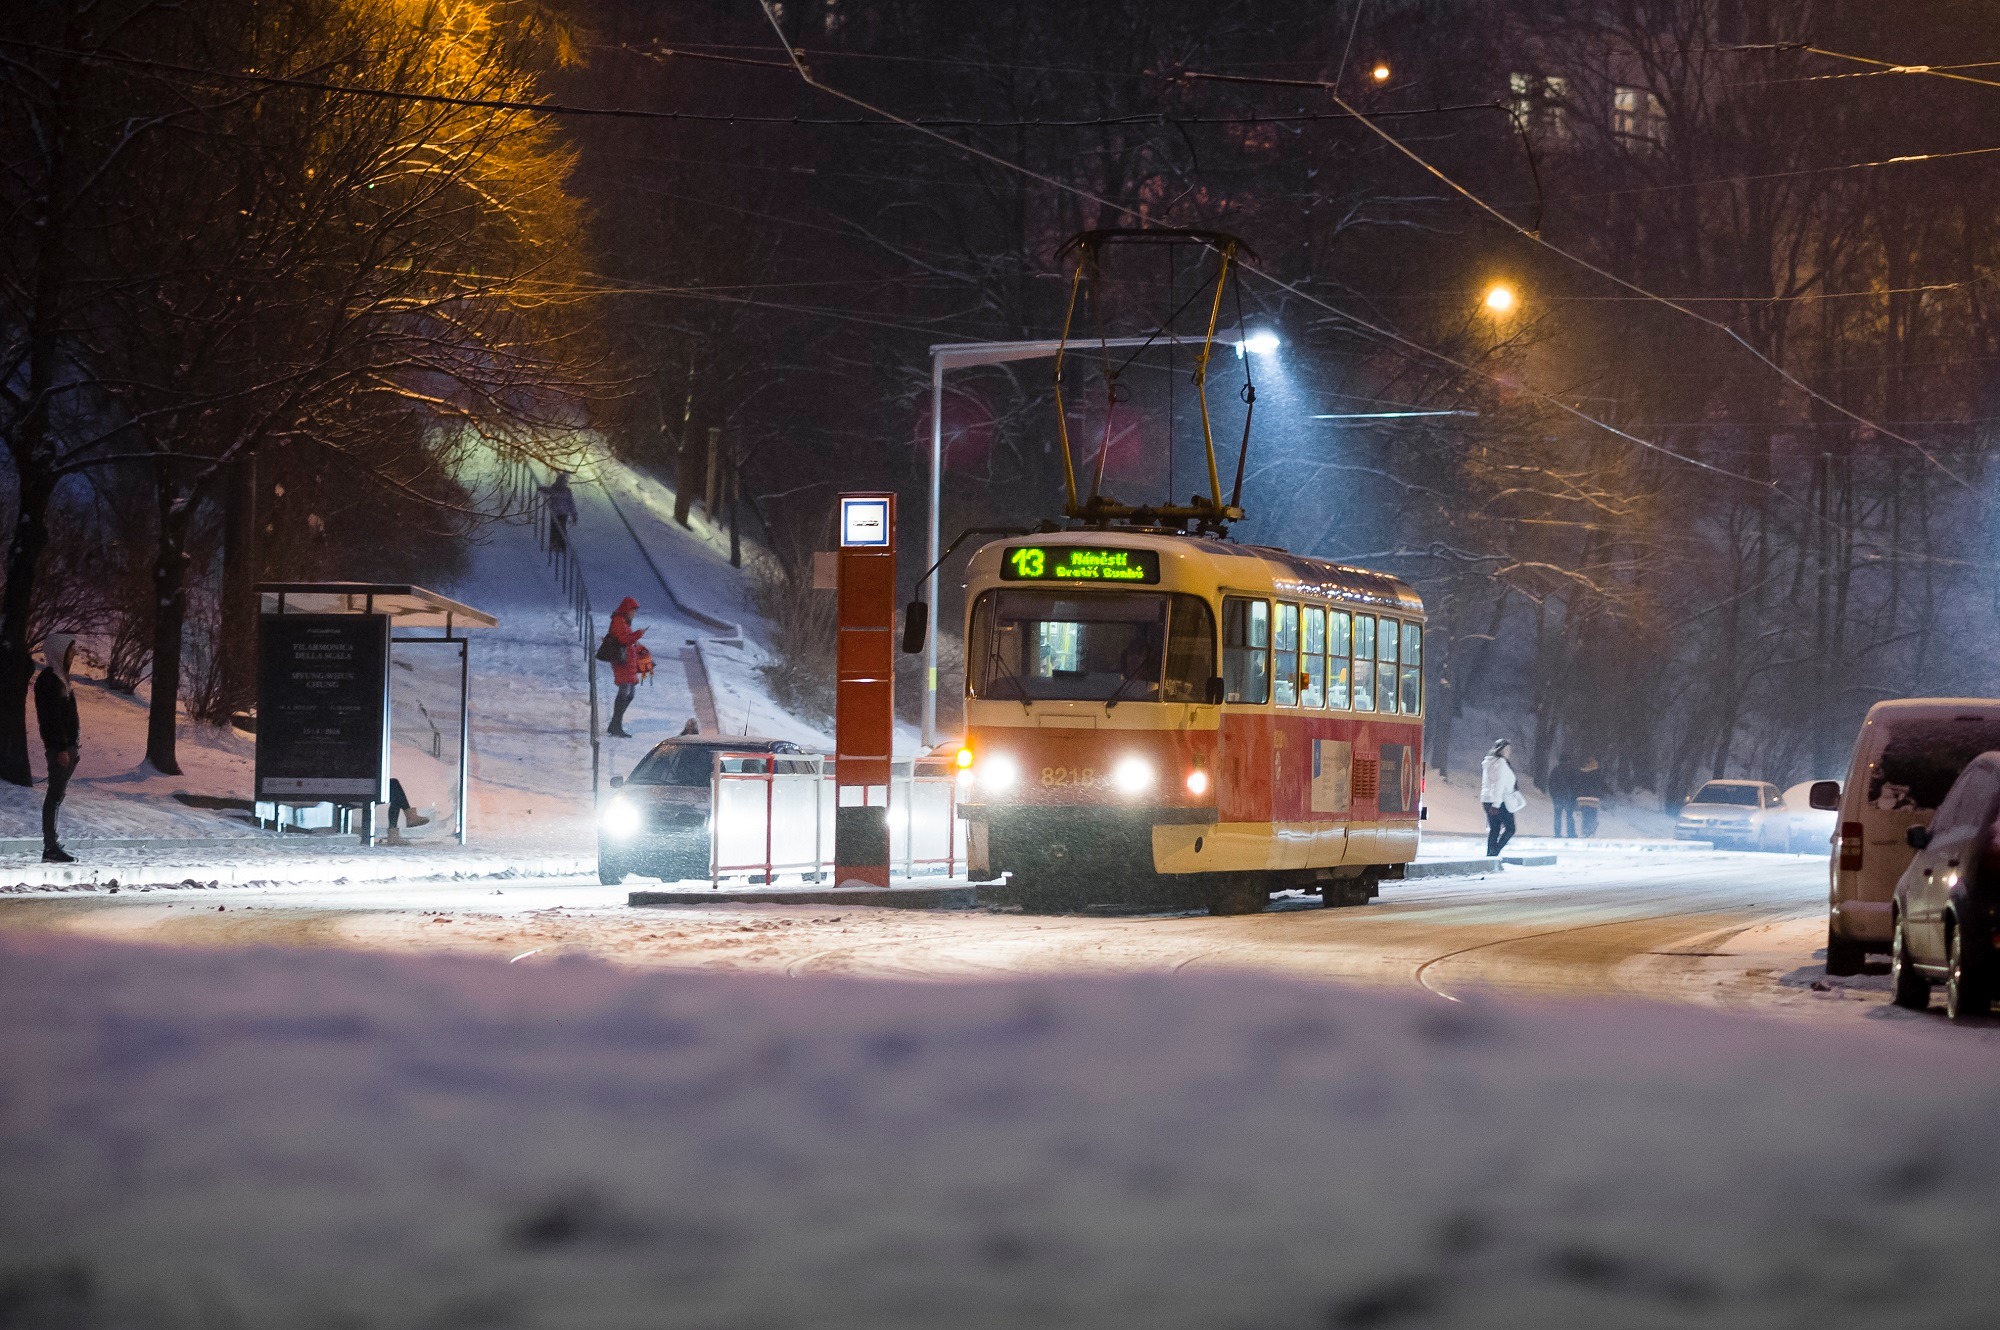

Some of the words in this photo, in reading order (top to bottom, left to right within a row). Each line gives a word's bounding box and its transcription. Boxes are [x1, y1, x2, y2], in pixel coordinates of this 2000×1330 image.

[1011, 548, 1045, 577] 13
[1072, 550, 1128, 566] Náměstí
[1040, 766, 1095, 787] 8218
